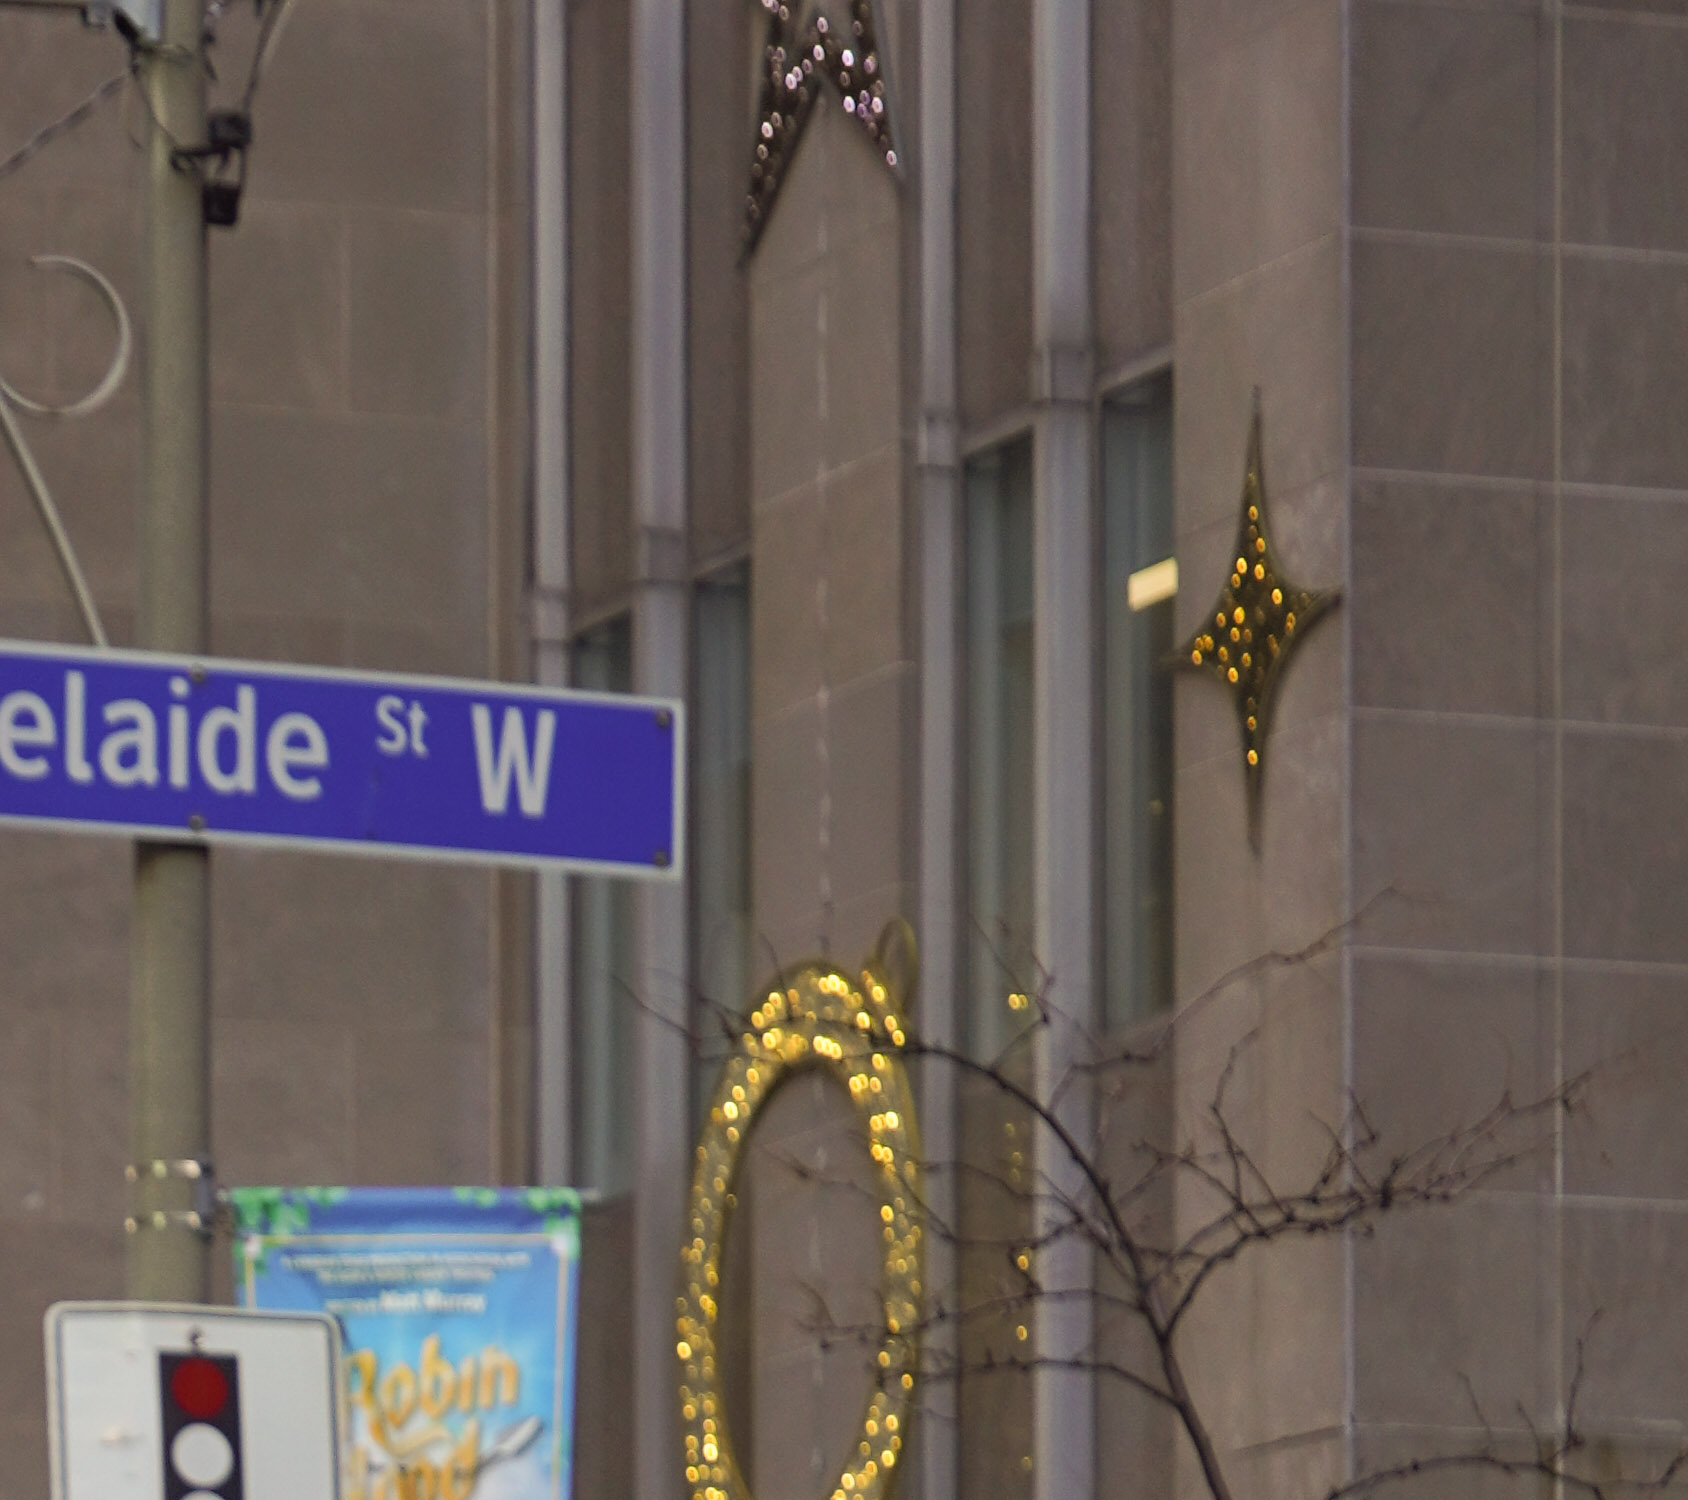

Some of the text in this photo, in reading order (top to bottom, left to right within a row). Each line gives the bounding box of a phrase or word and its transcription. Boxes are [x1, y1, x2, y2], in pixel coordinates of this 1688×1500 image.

[375, 696, 430, 759] St
[472, 705, 556, 817] W
[345, 1333, 520, 1455] Robin
